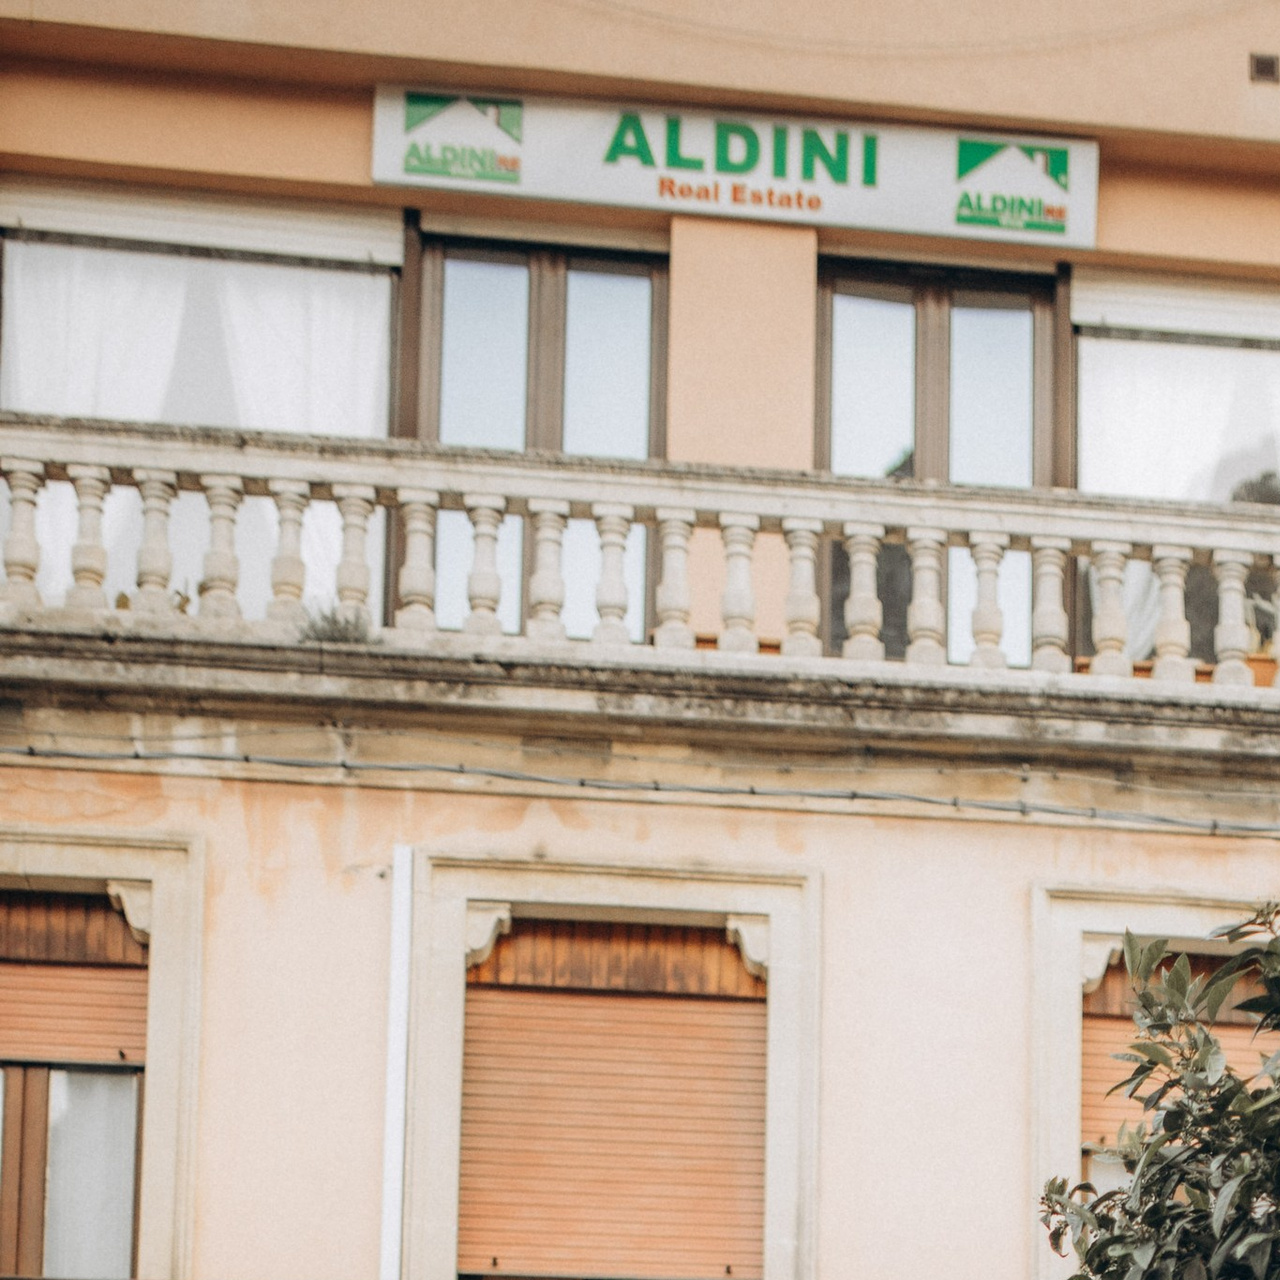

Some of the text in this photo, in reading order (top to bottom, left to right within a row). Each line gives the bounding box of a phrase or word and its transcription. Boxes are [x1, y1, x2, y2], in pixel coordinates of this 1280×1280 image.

[404, 139, 497, 171] ALDINI
[603, 110, 877, 187] ALDINI
[658, 176, 823, 211] Real Estate
[957, 190, 1043, 218] ALDINI
